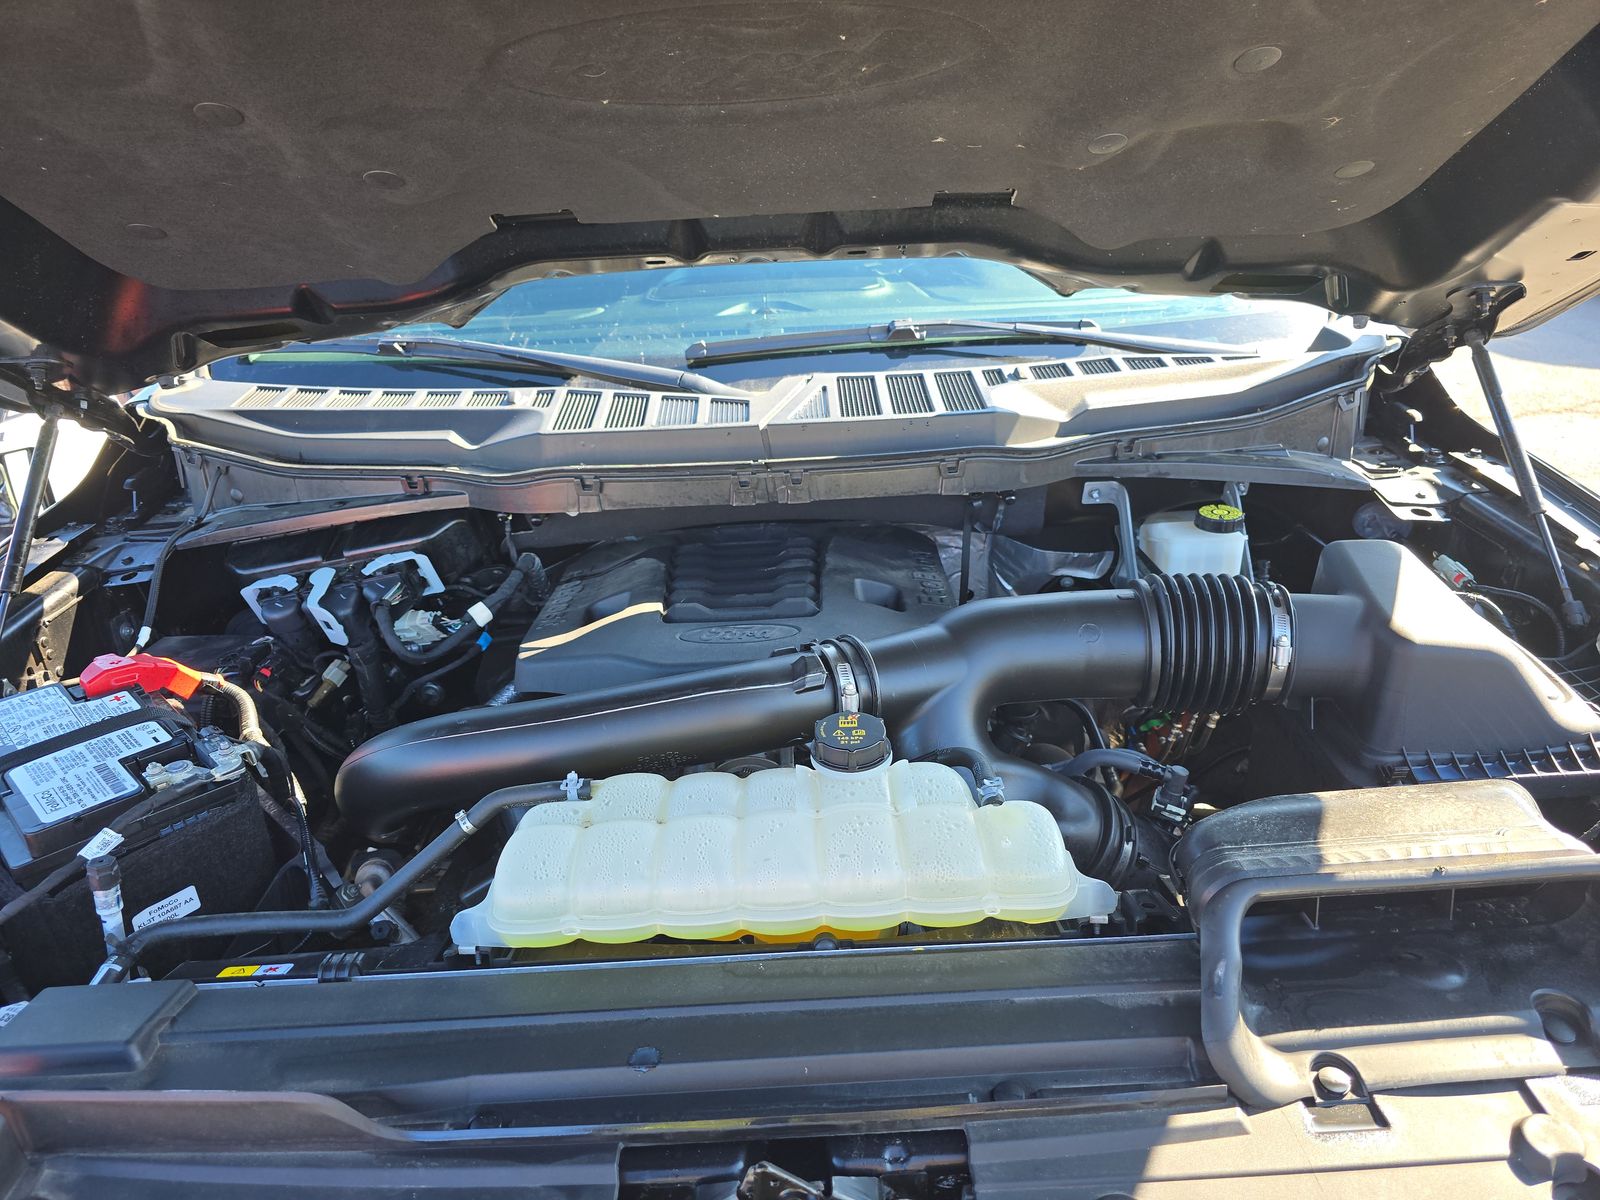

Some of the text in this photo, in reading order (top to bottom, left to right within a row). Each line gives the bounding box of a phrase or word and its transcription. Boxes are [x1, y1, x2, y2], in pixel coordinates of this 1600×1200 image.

[137, 916, 156, 929] KL3T
[183, 897, 194, 905] AA
[148, 898, 179, 916] FoMoCo
